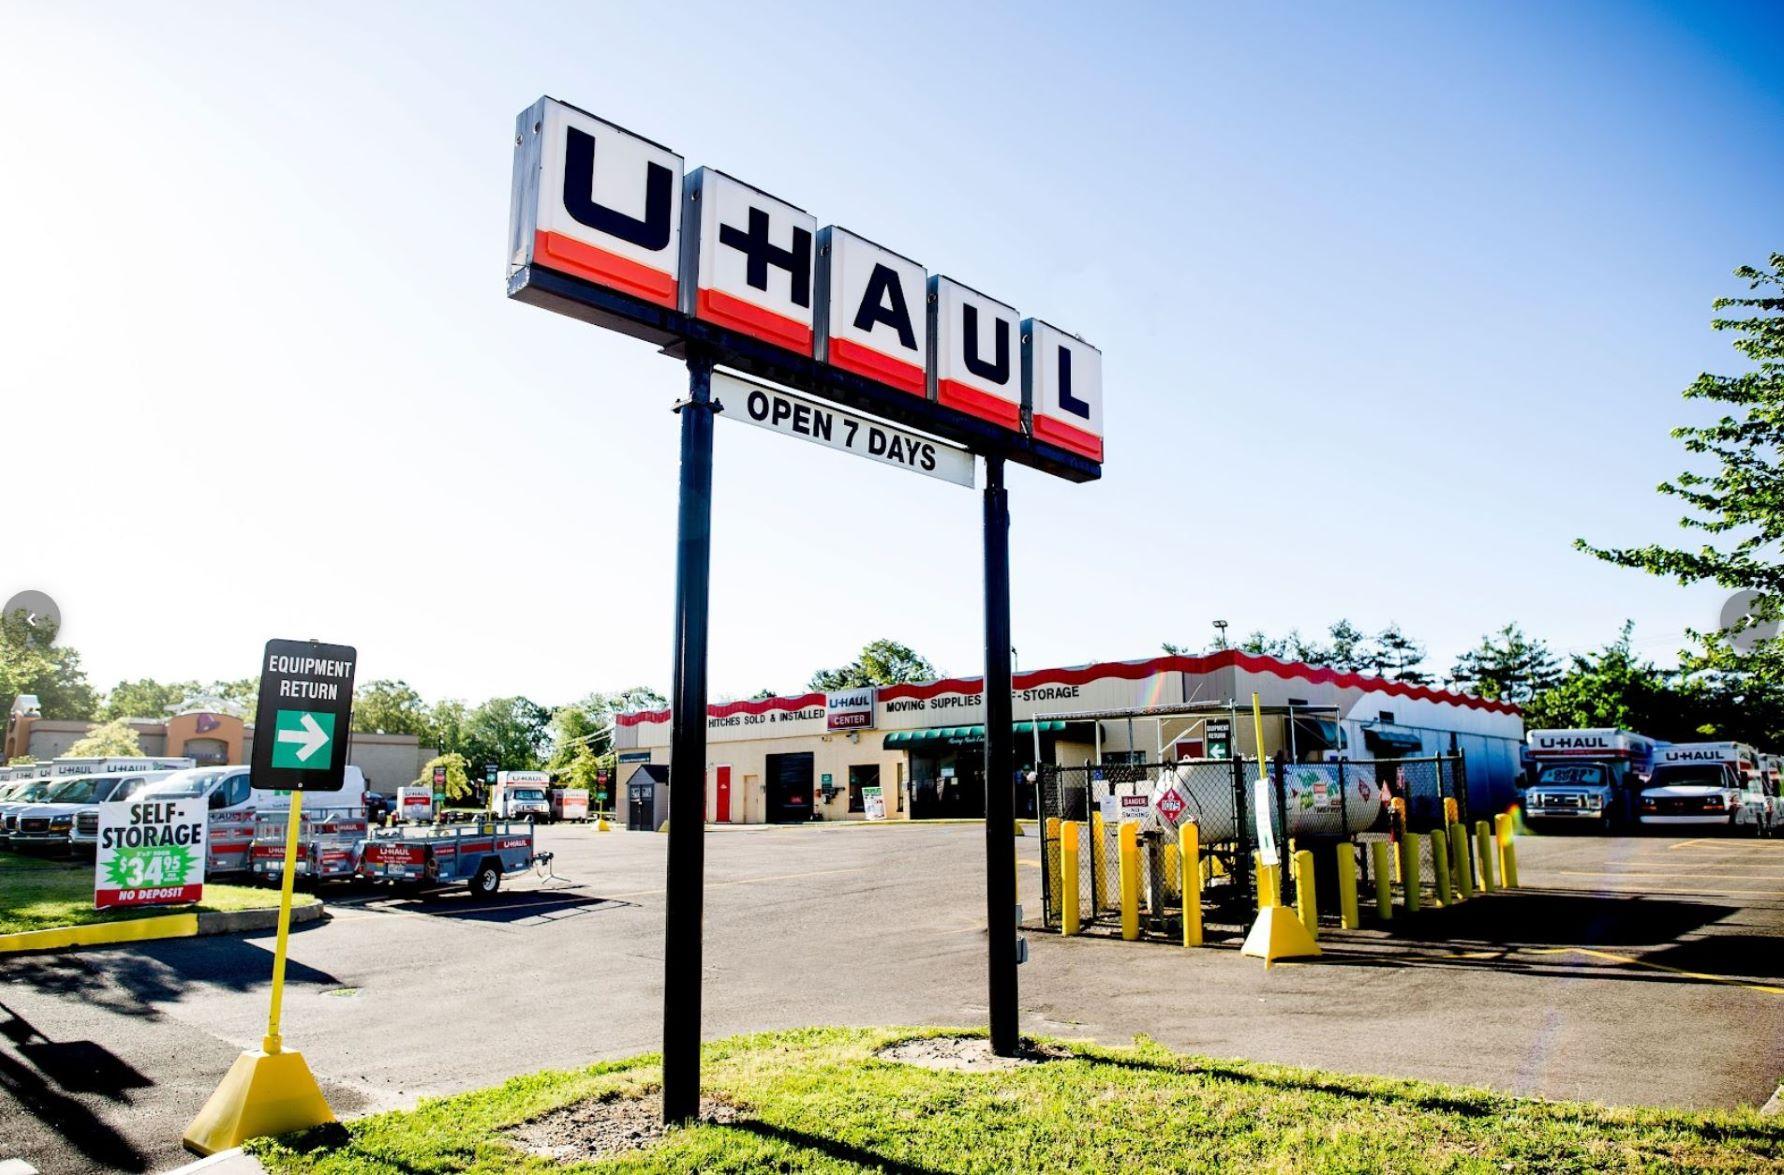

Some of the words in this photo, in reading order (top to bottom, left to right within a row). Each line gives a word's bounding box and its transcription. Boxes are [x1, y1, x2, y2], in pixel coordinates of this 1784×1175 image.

[563, 125, 1090, 420] U-HAUL
[747, 390, 832, 442] OPEN
[843, 418, 859, 448] 7
[868, 427, 936, 471] DAYS
[269, 655, 352, 678] EQUIPMENT
[280, 680, 338, 700] RETURN
[829, 695, 869, 709] U-HAUL
[886, 700, 925, 712] MOVING
[931, 695, 981, 709] SUPPLIES
[708, 717, 741, 728] HITCHES
[744, 715, 765, 724] SOLD
[770, 714, 775, 722] &
[780, 709, 825, 721] INSTALLED
[834, 714, 865, 725] CENTER
[1540, 737, 1608, 748] U-HAUL
[1666, 750, 1724, 761] U-HAUL
[59, 766, 93, 774] U-HAUL
[130, 802, 185, 825] SELF-
[102, 823, 202, 849] STORAGE
[503, 839, 528, 848] U-HAUL
[379, 848, 410, 856] U-HAUL
[118, 890, 136, 901] NO
[138, 887, 184, 899] DEPOSIT
